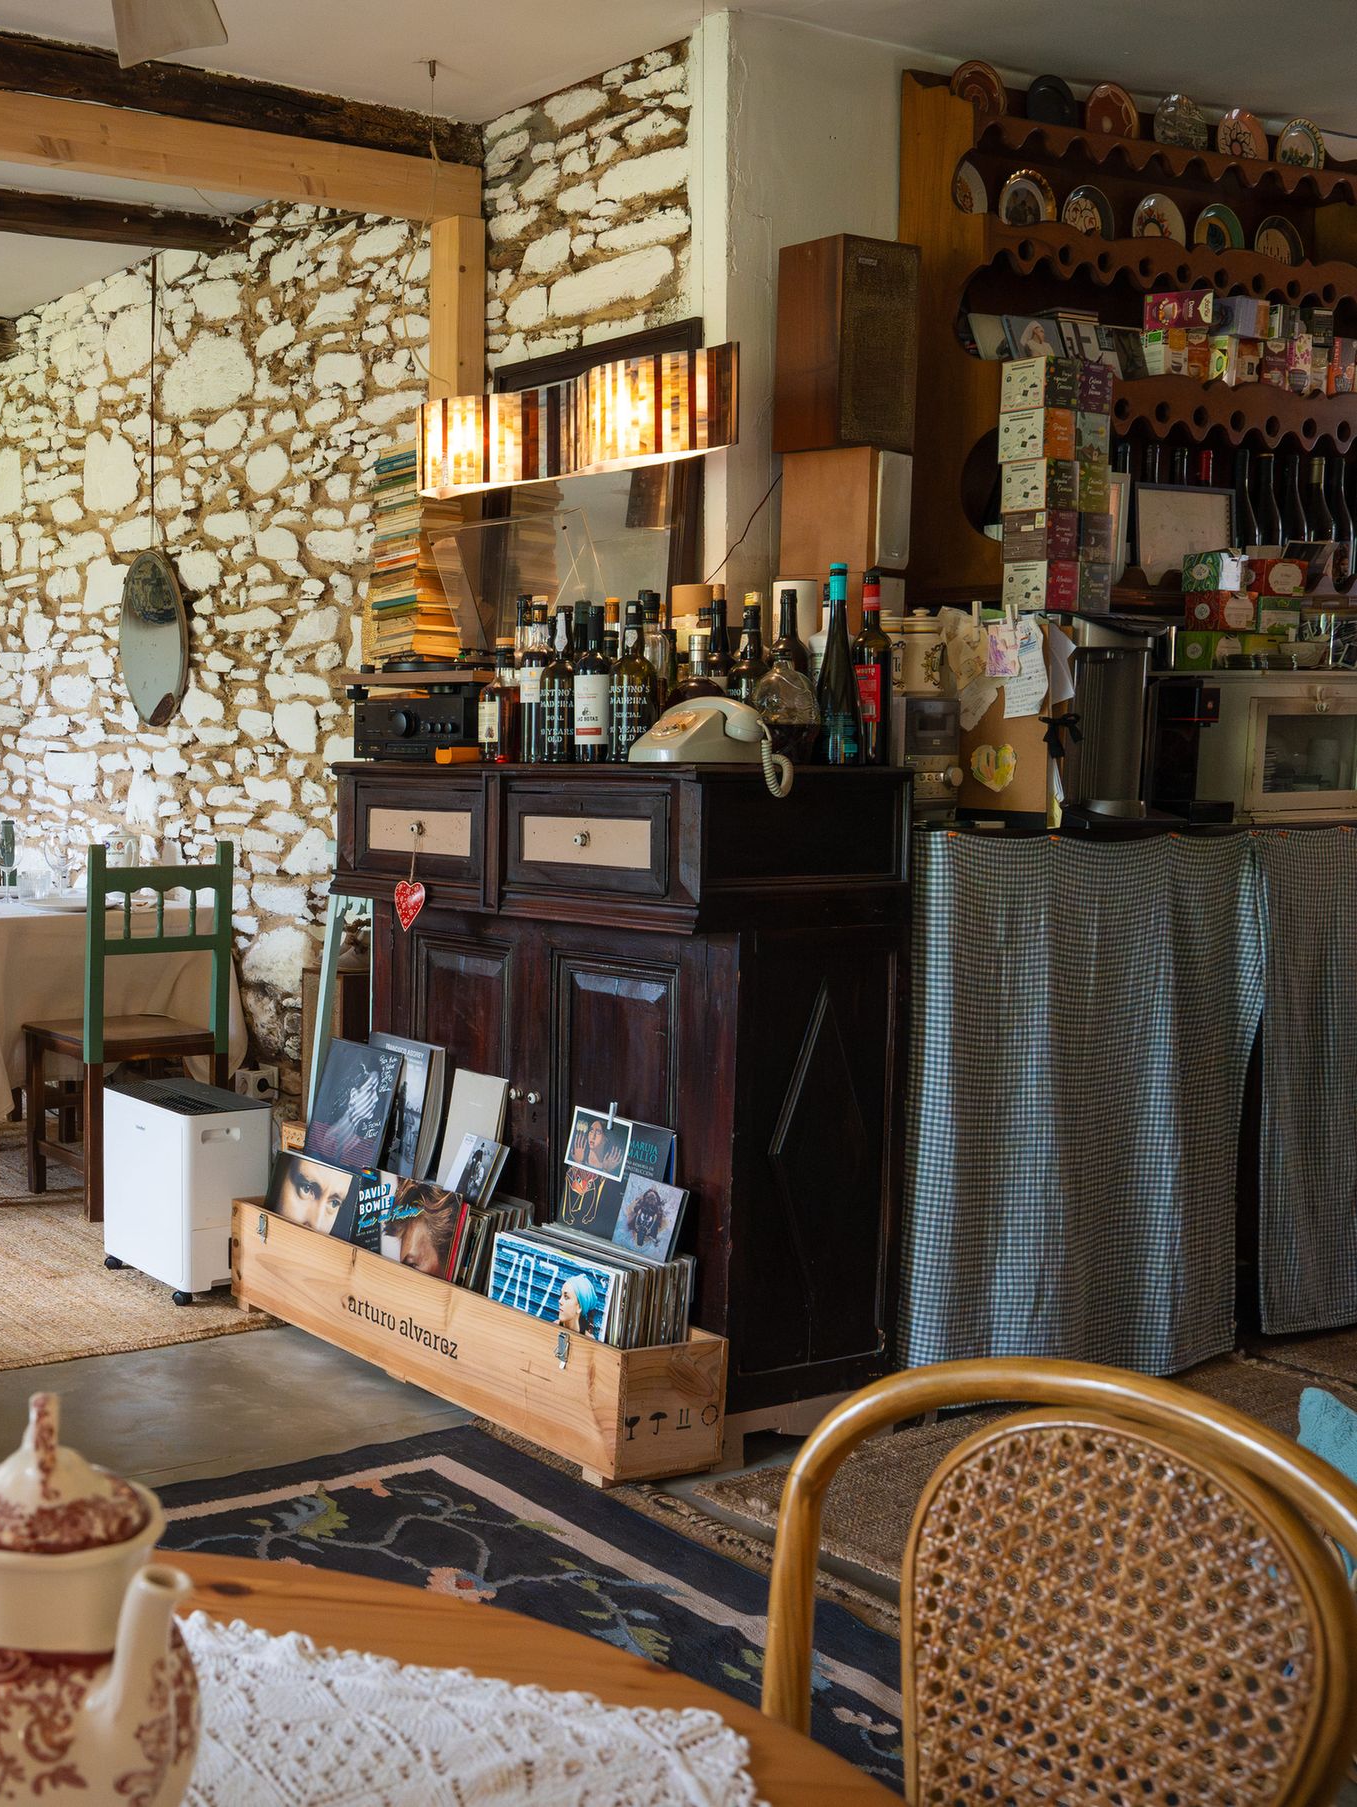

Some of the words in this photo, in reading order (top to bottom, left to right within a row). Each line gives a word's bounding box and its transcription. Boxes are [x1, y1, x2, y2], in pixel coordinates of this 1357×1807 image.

[609, 696, 648, 705] MADEIRA
[547, 735, 563, 743] OLD
[618, 734, 635, 742] OLD
[629, 1140, 659, 1155] MARUJA
[628, 1149, 658, 1164] MALLO
[358, 1184, 388, 1202] DAVID
[359, 1197, 391, 1215] BOWIE
[498, 1247, 559, 1318] 707
[348, 1295, 396, 1331] arturo
[399, 1317, 458, 1360] alvarez
